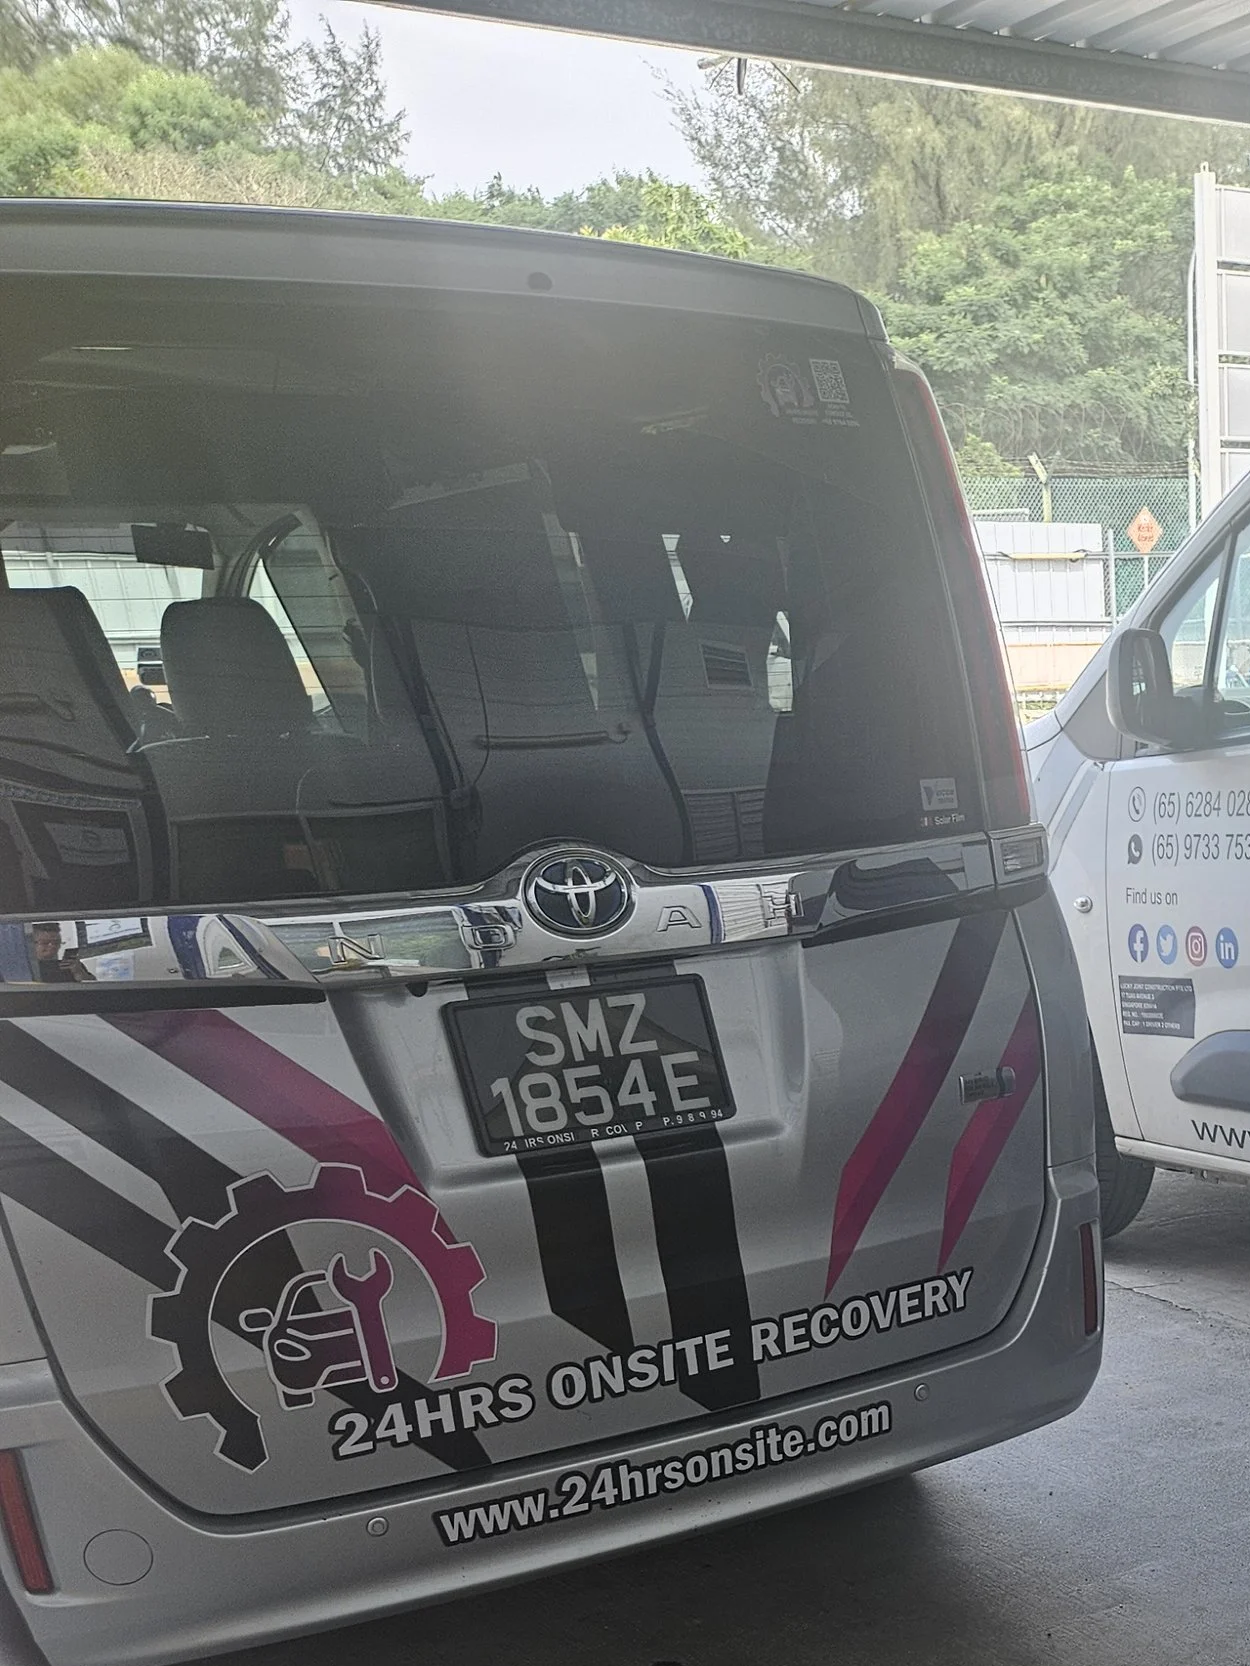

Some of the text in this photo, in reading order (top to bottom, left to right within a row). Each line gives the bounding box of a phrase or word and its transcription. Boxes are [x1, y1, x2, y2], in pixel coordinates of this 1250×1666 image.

[1153, 791, 1181, 825] (65)
[1185, 791, 1222, 818] 6284
[1152, 833, 1179, 867] (65)
[1184, 833, 1220, 860] 9733
[1126, 887, 1178, 905] Find us on
[515, 992, 659, 1067] SMZ
[490, 1050, 711, 1137] 1854E
[334, 1270, 973, 1458] 24HRS ONSITE RECOVERY
[439, 1403, 892, 1544] www.24hrsonsite.com
